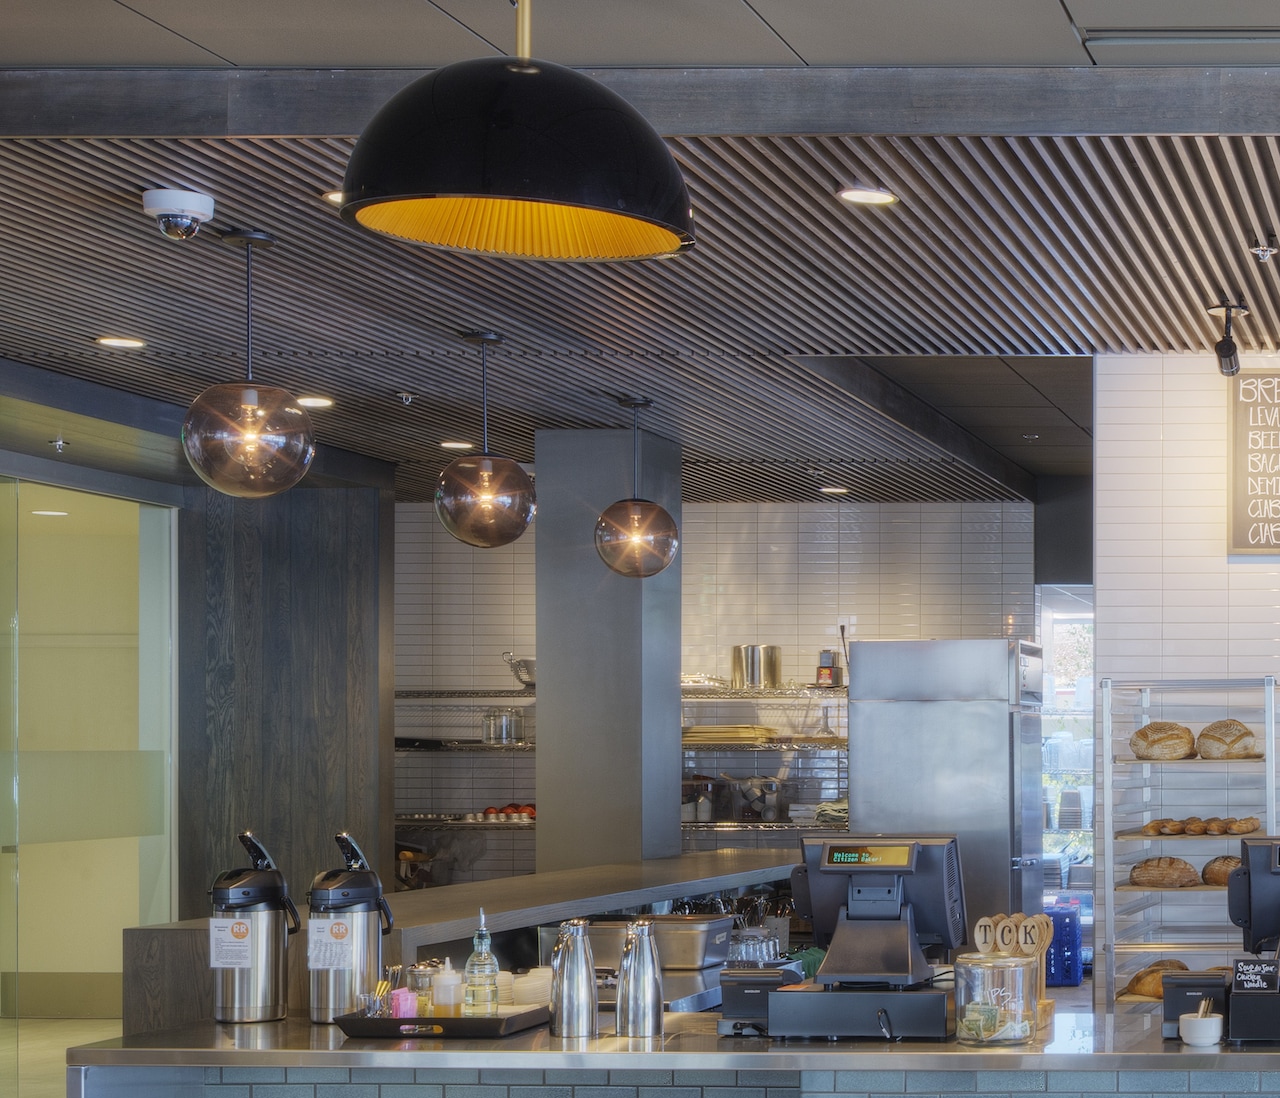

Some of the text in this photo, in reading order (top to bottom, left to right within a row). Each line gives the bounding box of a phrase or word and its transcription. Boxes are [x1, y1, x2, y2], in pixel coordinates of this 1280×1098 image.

[234, 924, 246, 932] RR
[332, 925, 346, 933] RR
[979, 925, 992, 944] T
[1001, 925, 1012, 945] C
[1022, 924, 1036, 944] K
[1236, 972, 1261, 982] Chicken
[1244, 979, 1268, 988] Noodle
